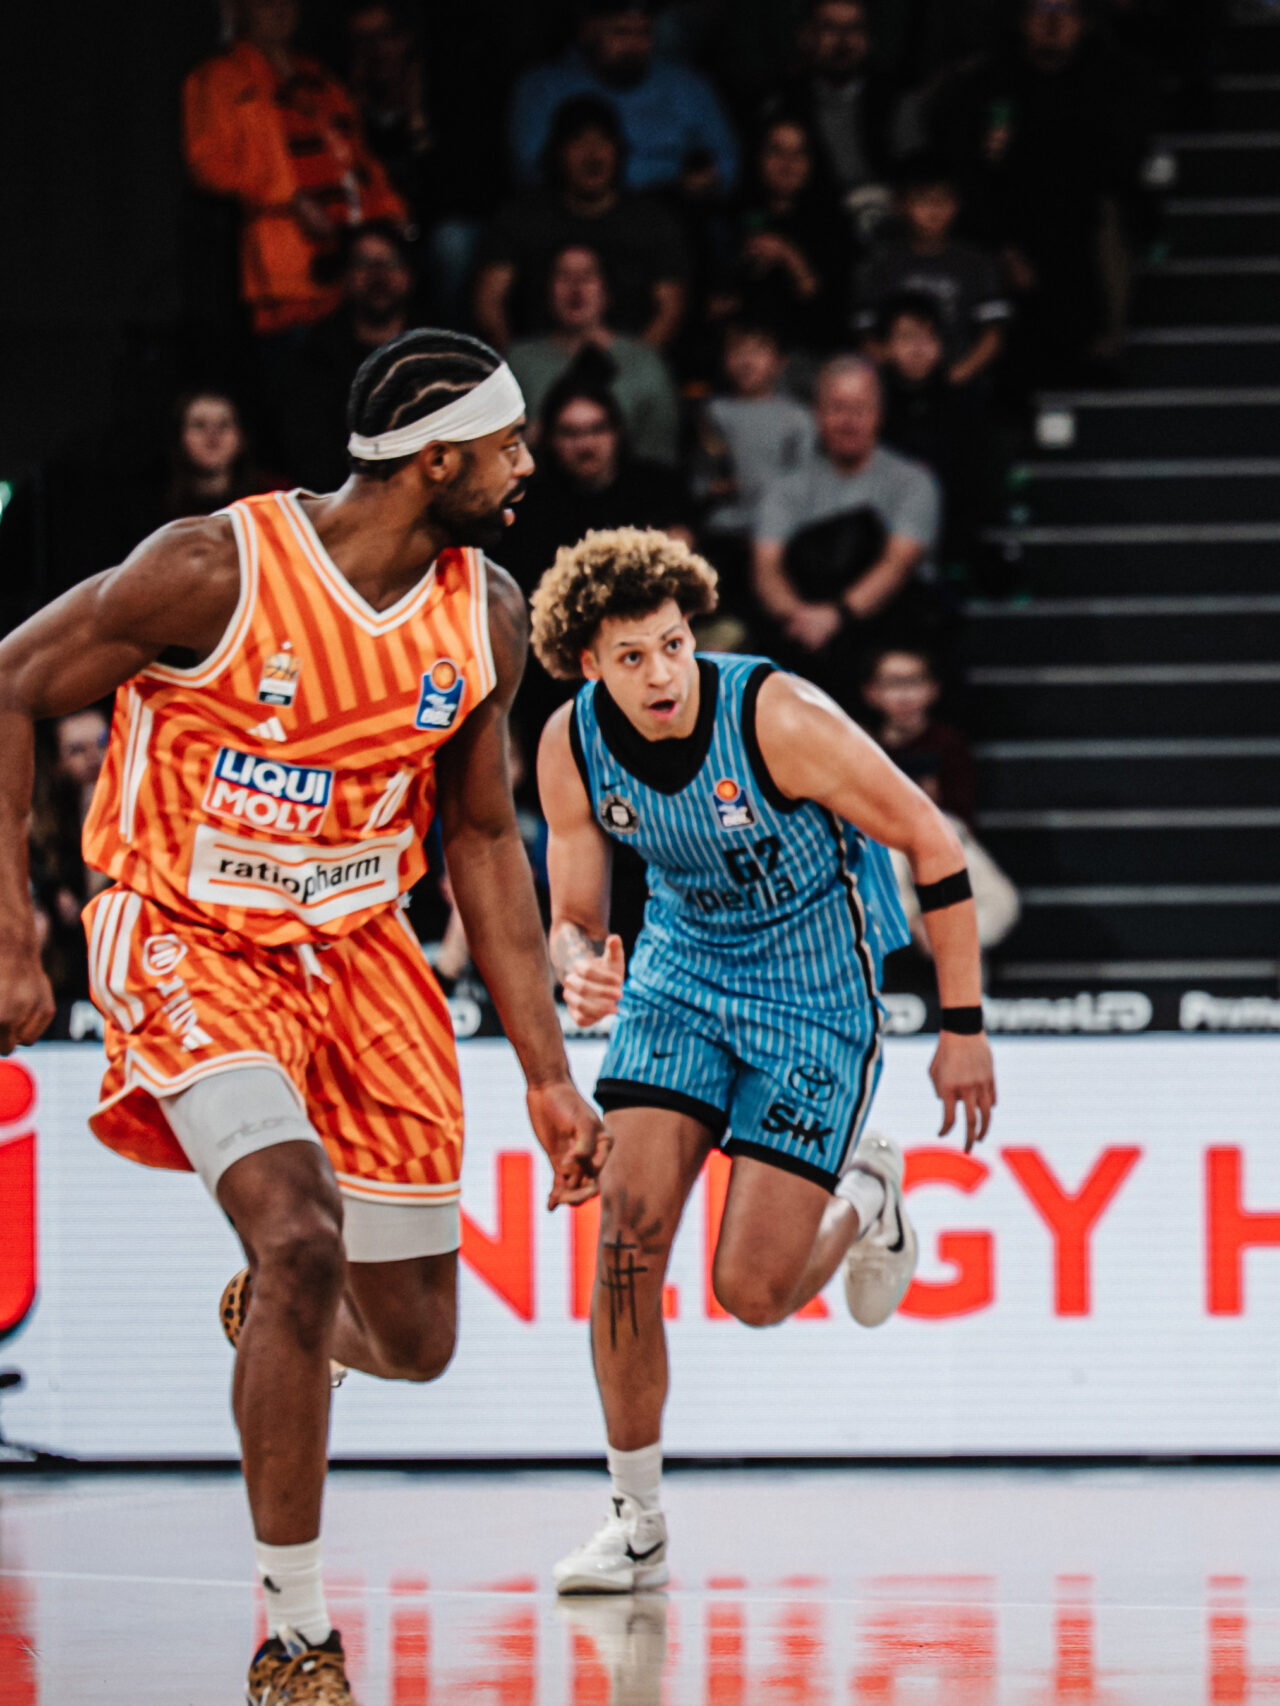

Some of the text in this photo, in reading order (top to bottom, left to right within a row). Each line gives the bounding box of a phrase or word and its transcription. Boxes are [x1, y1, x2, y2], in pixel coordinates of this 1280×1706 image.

[219, 750, 327, 804] LIQUI
[210, 781, 323, 831] MOLY
[219, 855, 381, 904] ratiopharm
[684, 876, 798, 915] peria
